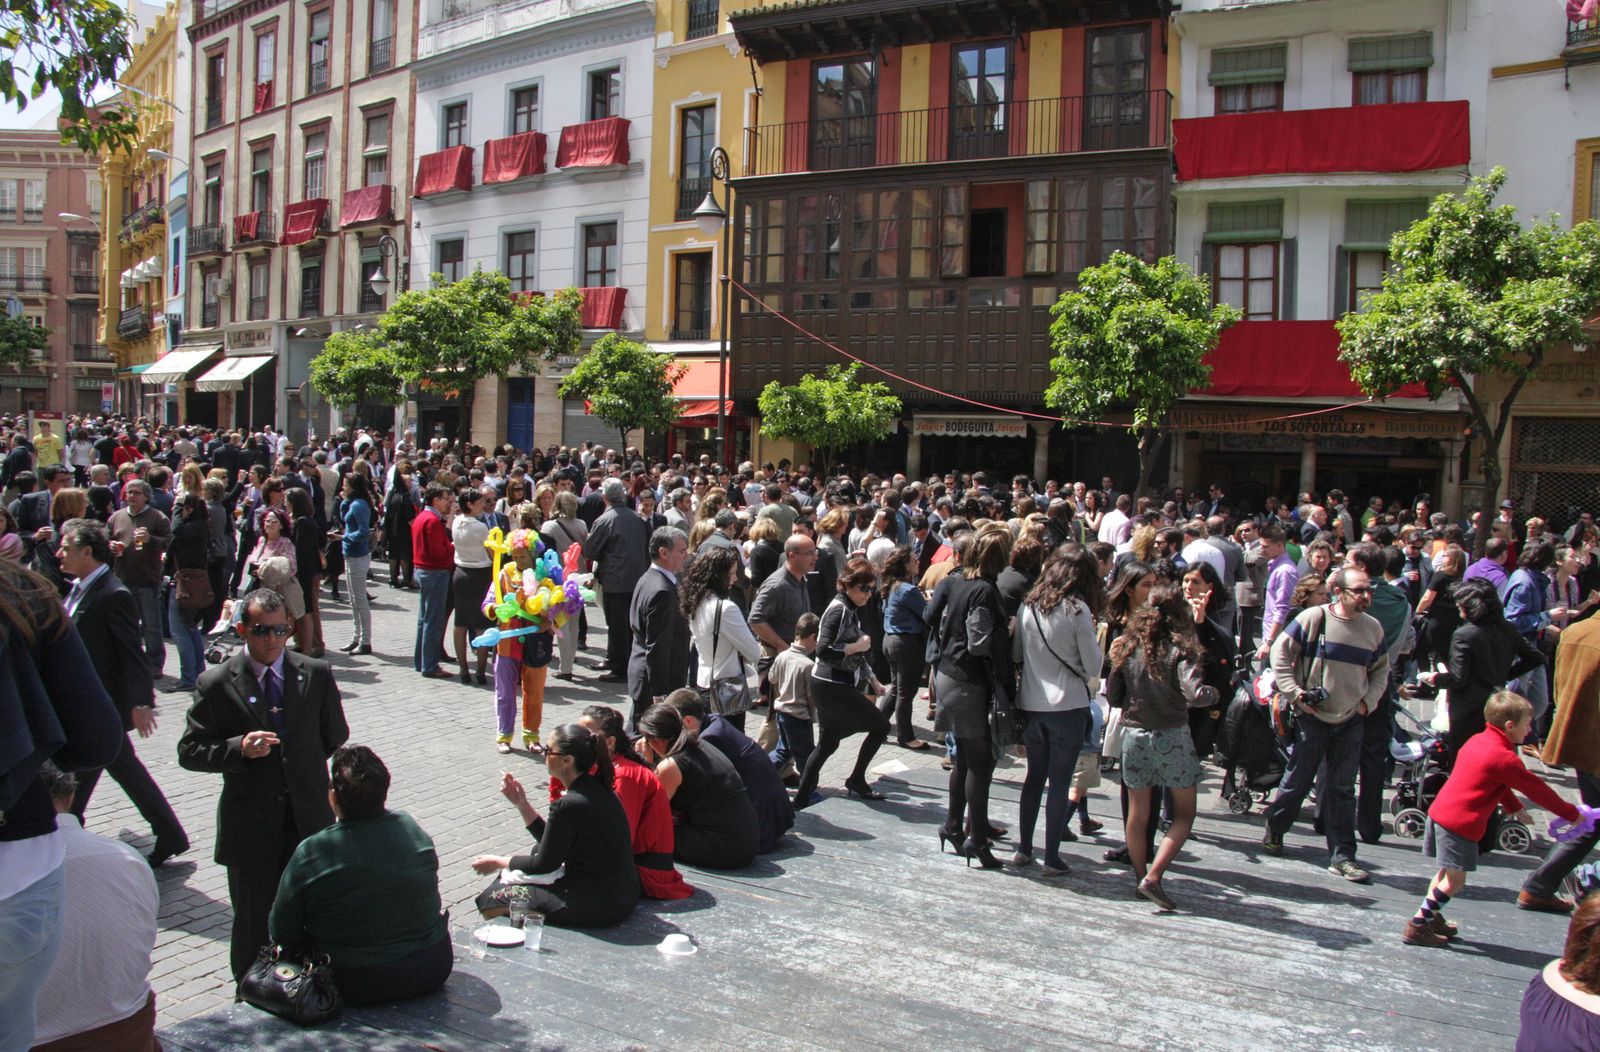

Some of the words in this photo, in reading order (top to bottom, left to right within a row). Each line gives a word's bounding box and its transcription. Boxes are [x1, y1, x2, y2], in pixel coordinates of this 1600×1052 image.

[945, 422, 994, 432] BODEGUITA
[1264, 421, 1287, 431] LOS
[1289, 421, 1366, 433] SOPORTALES
[1385, 421, 1456, 432] BARBADILLO
